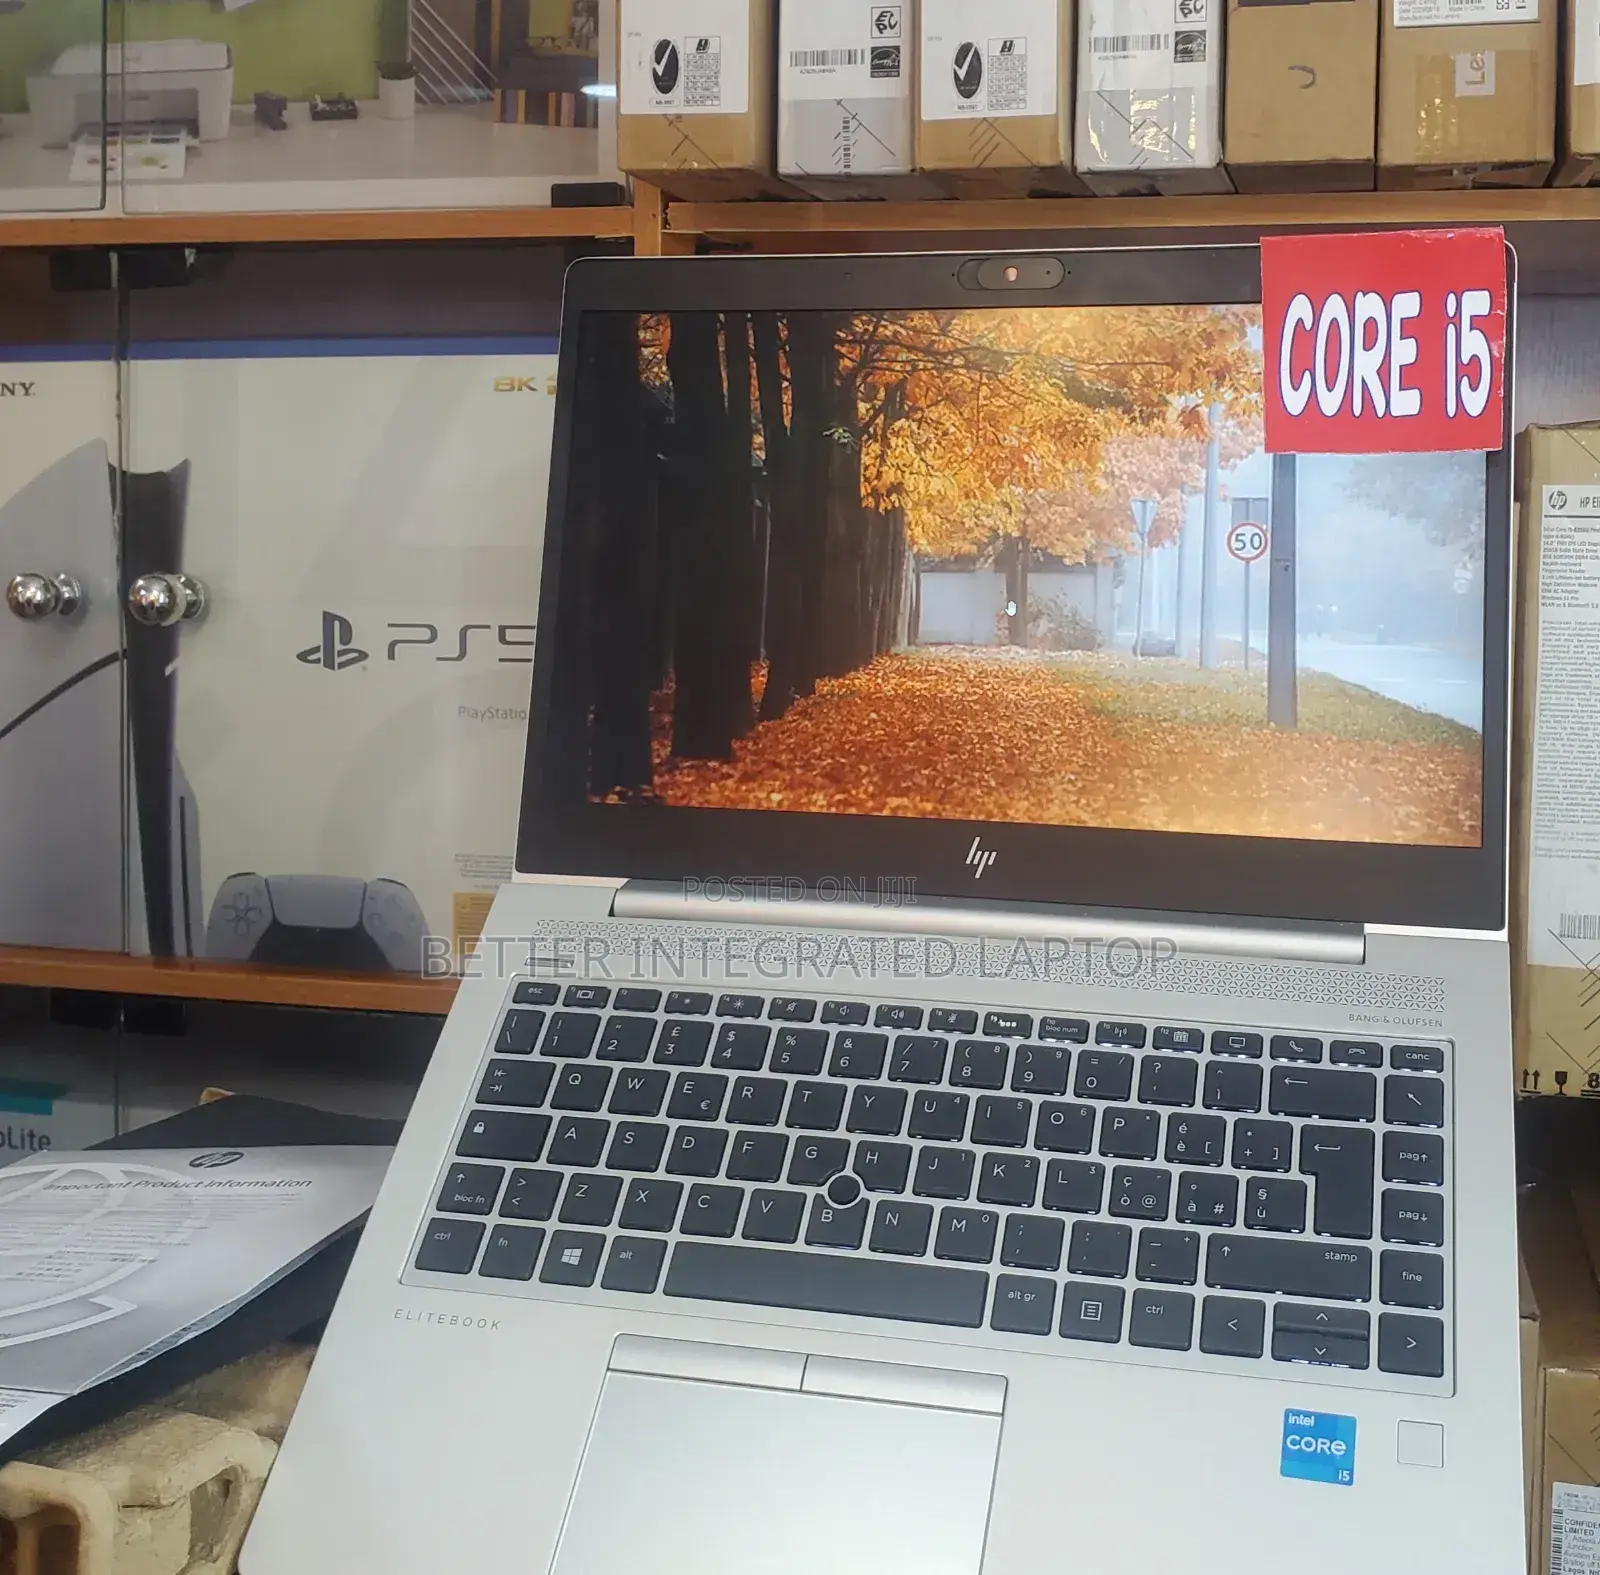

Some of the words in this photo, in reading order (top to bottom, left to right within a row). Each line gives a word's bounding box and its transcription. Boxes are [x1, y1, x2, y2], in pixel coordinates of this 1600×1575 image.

[1279, 289, 1422, 419] CORE
[1445, 289, 1493, 419] i5
[493, 376, 539, 393] 8K
[1579, 496, 1591, 508] HP
[1234, 532, 1264, 551] 50
[387, 622, 536, 663] PS5
[965, 836, 997, 879] hp
[1349, 1013, 1379, 1024] BANG
[1383, 1016, 1390, 1024] &
[1393, 1016, 1443, 1028] OLUFSEN
[672, 1027, 681, 1036] £
[727, 1031, 736, 1042] $
[553, 1036, 558, 1046] 1
[608, 1040, 617, 1050] 2
[786, 1036, 796, 1046] %
[844, 1038, 852, 1048] &
[666, 1044, 675, 1054] 3
[722, 1048, 732, 1058] 4
[781, 1052, 791, 1063] 5
[840, 1057, 849, 1067] 6
[902, 1061, 909, 1071] 7
[962, 1066, 971, 1076] 8
[1154, 1063, 1161, 1073] ?
[569, 1074, 581, 1085] Q
[1024, 1072, 1033, 1082] 9
[1587, 1072, 1600, 1089] 8
[629, 1078, 645, 1089] W
[683, 1082, 695, 1093] E
[742, 1087, 753, 1098] R
[803, 1091, 812, 1102] T
[701, 1100, 710, 1110] €
[865, 1096, 875, 1107] Y
[925, 1101, 936, 1112] U
[1051, 1113, 1064, 1124] O
[1081, 1108, 1087, 1116] 6
[1114, 1118, 1125, 1130] P
[1179, 1123, 1187, 1134] é
[565, 1128, 576, 1139] A
[624, 1132, 635, 1144] S
[682, 1137, 695, 1148] D
[743, 1142, 754, 1153] F
[1177, 1141, 1185, 1151] è
[806, 1147, 817, 1158] G
[866, 1152, 878, 1164] H
[1400, 1152, 1419, 1161] pag
[929, 1158, 938, 1170] J
[994, 1164, 1005, 1177] K
[1058, 1171, 1068, 1183] L
[1090, 1166, 1095, 1174] 3
[42, 1181, 131, 1191] Important
[132, 1179, 203, 1189] Product
[203, 1178, 313, 1189] Information
[1124, 1177, 1132, 1187] ç
[576, 1185, 588, 1197] Z
[636, 1190, 649, 1202] X
[1258, 1189, 1267, 1200] §
[454, 1194, 473, 1202] bloc
[698, 1196, 710, 1208] C
[1121, 1194, 1130, 1205] ò
[1142, 1195, 1156, 1208] @
[762, 1200, 773, 1213] V
[1188, 1200, 1196, 1212] à
[1214, 1204, 1224, 1214] #
[1258, 1206, 1265, 1218] ù
[822, 1210, 833, 1222] B
[886, 1212, 899, 1226] N
[1400, 1212, 1419, 1220] pag
[952, 1219, 966, 1232] M
[499, 1238, 508, 1246] fn
[620, 1251, 633, 1259] alt
[1325, 1252, 1357, 1262] stamp
[1403, 1272, 1422, 1281] fine
[1008, 1290, 1021, 1299] alt
[1024, 1294, 1035, 1302] gr
[1146, 1306, 1163, 1314] ctrl
[393, 1308, 501, 1331] ELITEBOOK
[1288, 1413, 1315, 1428] intel
[1338, 1469, 1350, 1482] i5
[1564, 1527, 1594, 1537] LIMITED
